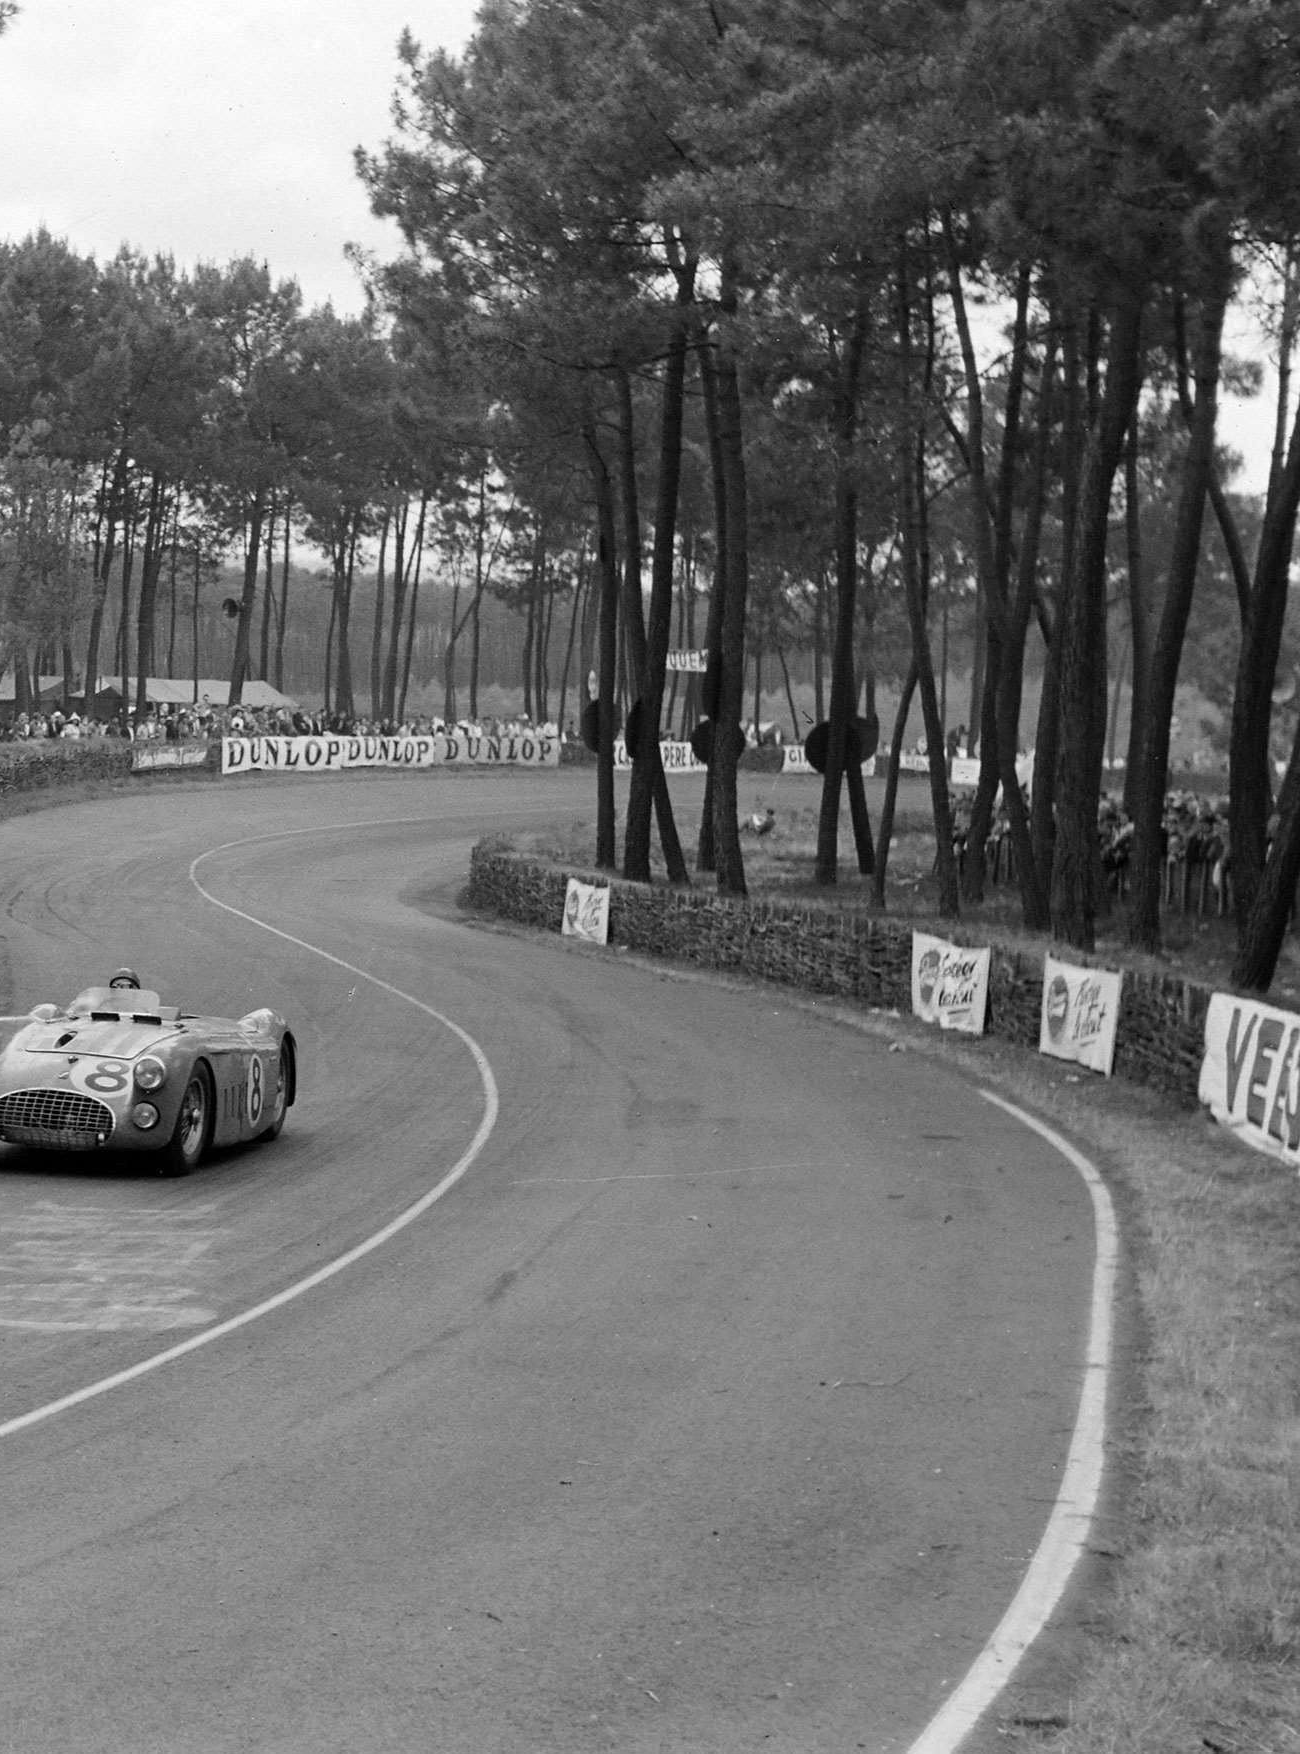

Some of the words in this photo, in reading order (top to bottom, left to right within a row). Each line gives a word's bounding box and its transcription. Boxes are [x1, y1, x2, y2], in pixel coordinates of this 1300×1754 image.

[228, 738, 340, 768] DUNLOP
[349, 736, 430, 762] DUNLOP
[445, 737, 552, 761] DUNLOP
[84, 1061, 130, 1093] 8
[251, 1058, 261, 1121] 8
